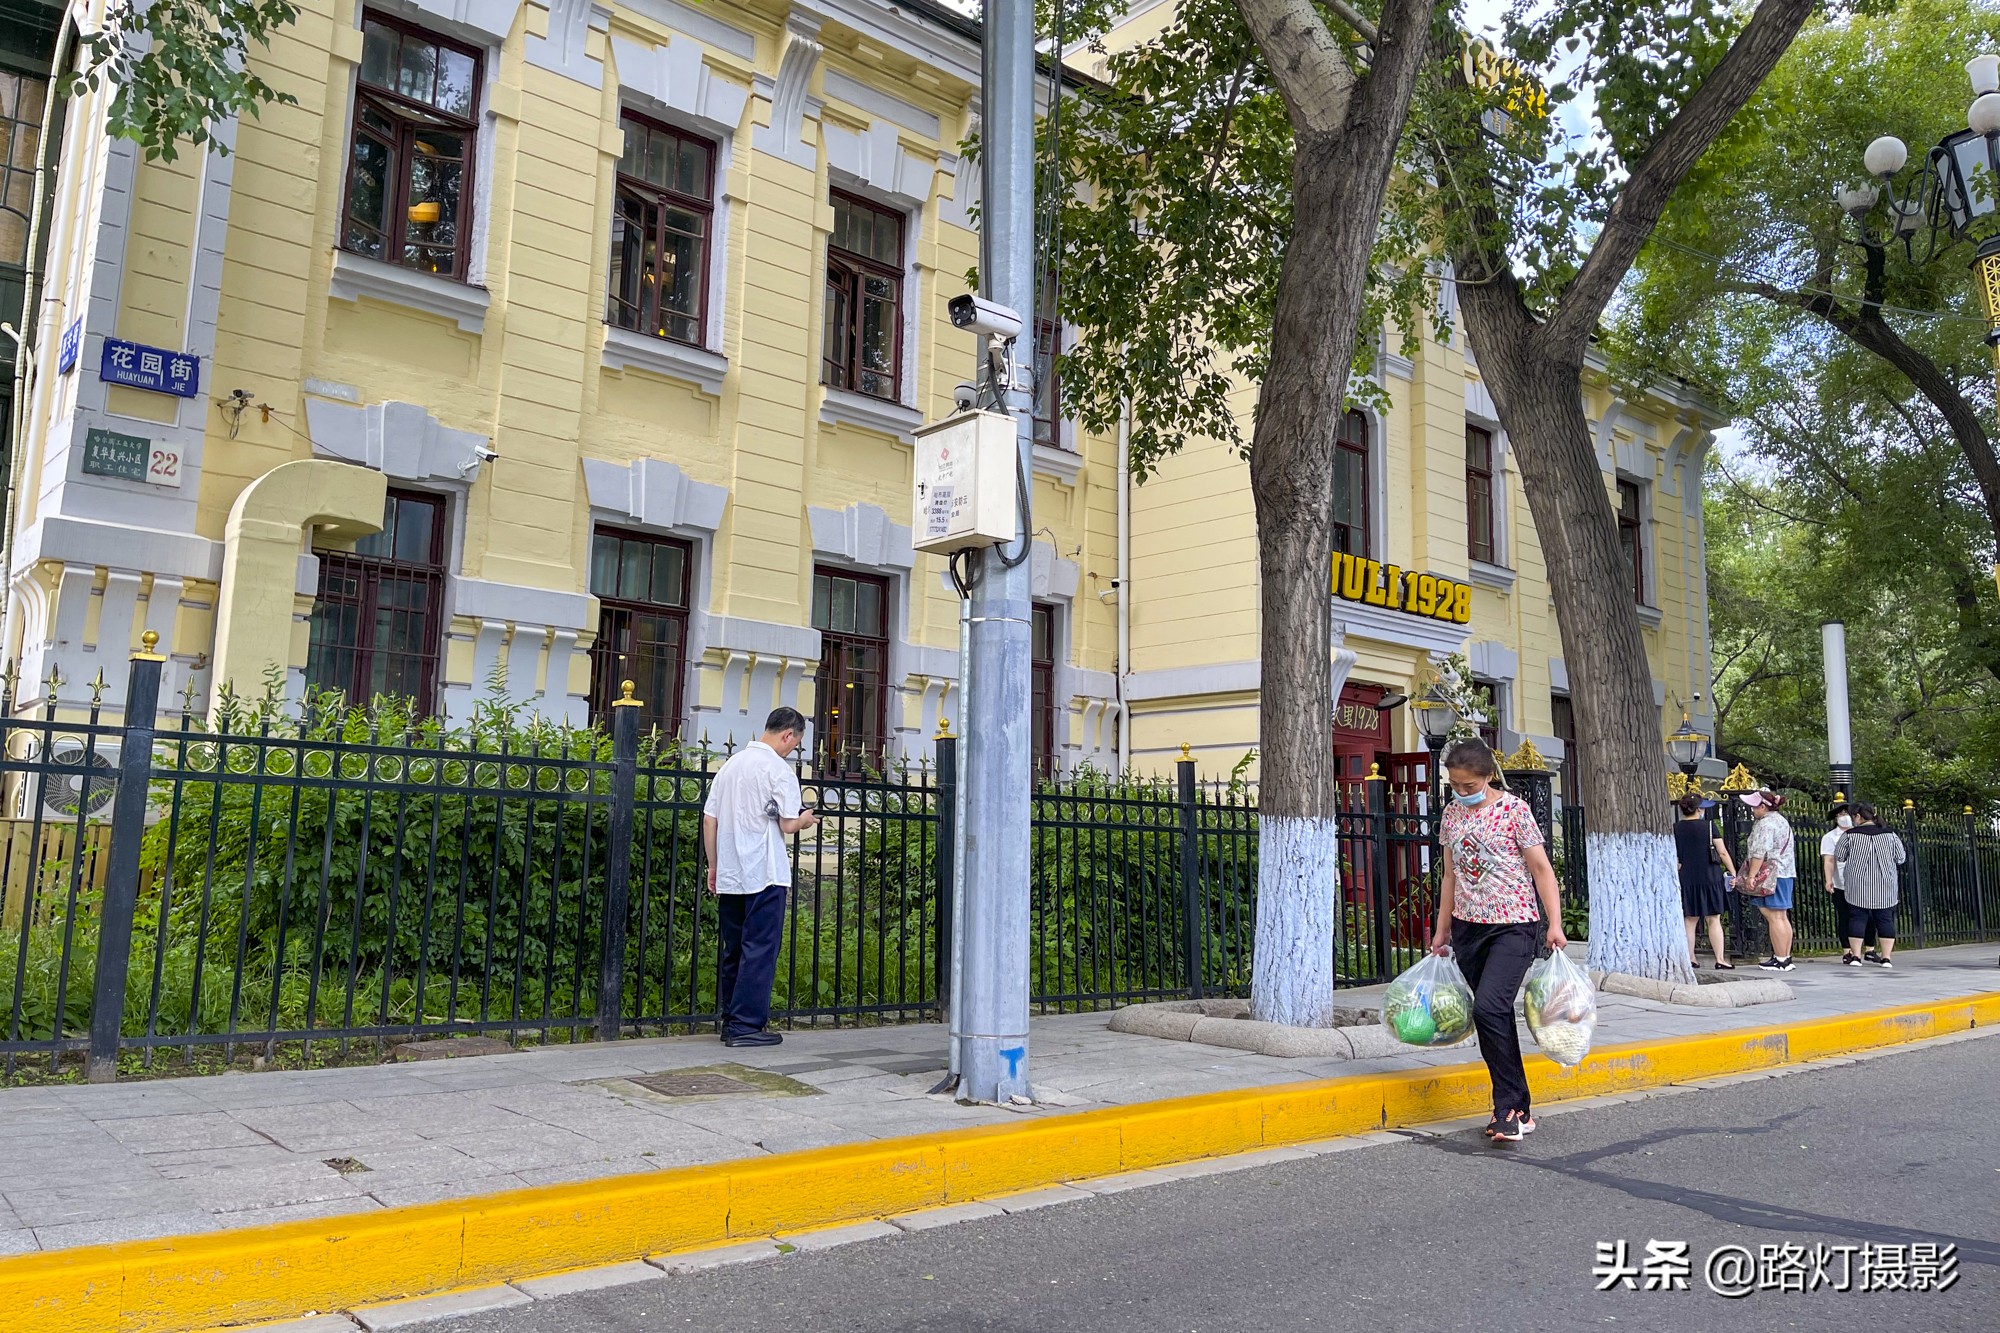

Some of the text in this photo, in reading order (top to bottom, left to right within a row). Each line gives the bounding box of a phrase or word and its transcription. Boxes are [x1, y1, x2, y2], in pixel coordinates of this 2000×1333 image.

[111, 345, 193, 381] 花园街
[116, 370, 186, 392] HUAYUAN JIE
[88, 460, 141, 477] 职工住宅
[150, 450, 178, 477] 22
[1404, 572, 1472, 624] 1928
